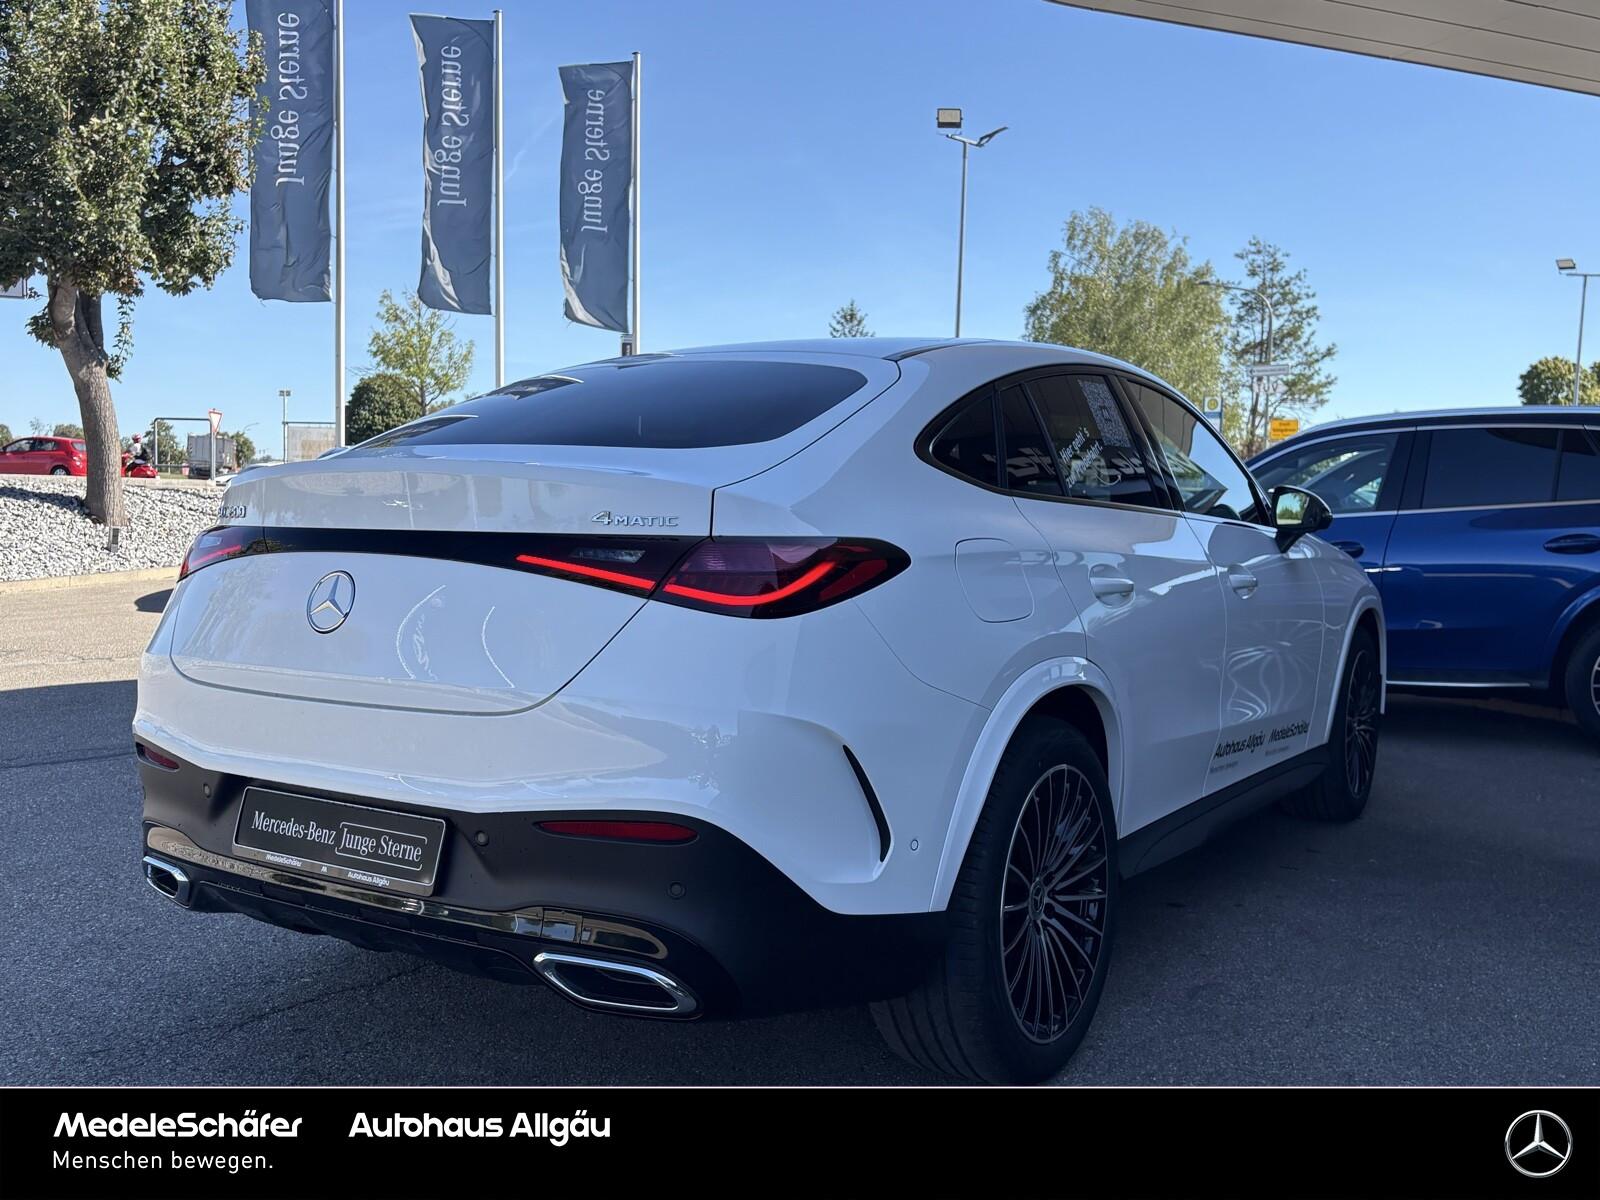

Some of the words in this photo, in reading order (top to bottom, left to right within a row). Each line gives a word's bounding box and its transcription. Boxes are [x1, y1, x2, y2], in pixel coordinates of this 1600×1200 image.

[1059, 444, 1073, 464] Hier
[592, 511, 679, 526] 4MATIC
[1214, 740, 1247, 758] Autohaus
[251, 810, 336, 845] Mercedes-Benz
[339, 827, 376, 856] Junge
[378, 835, 422, 862] Sterne
[347, 871, 372, 883] Autohaus
[372, 877, 390, 888] Allgäu
